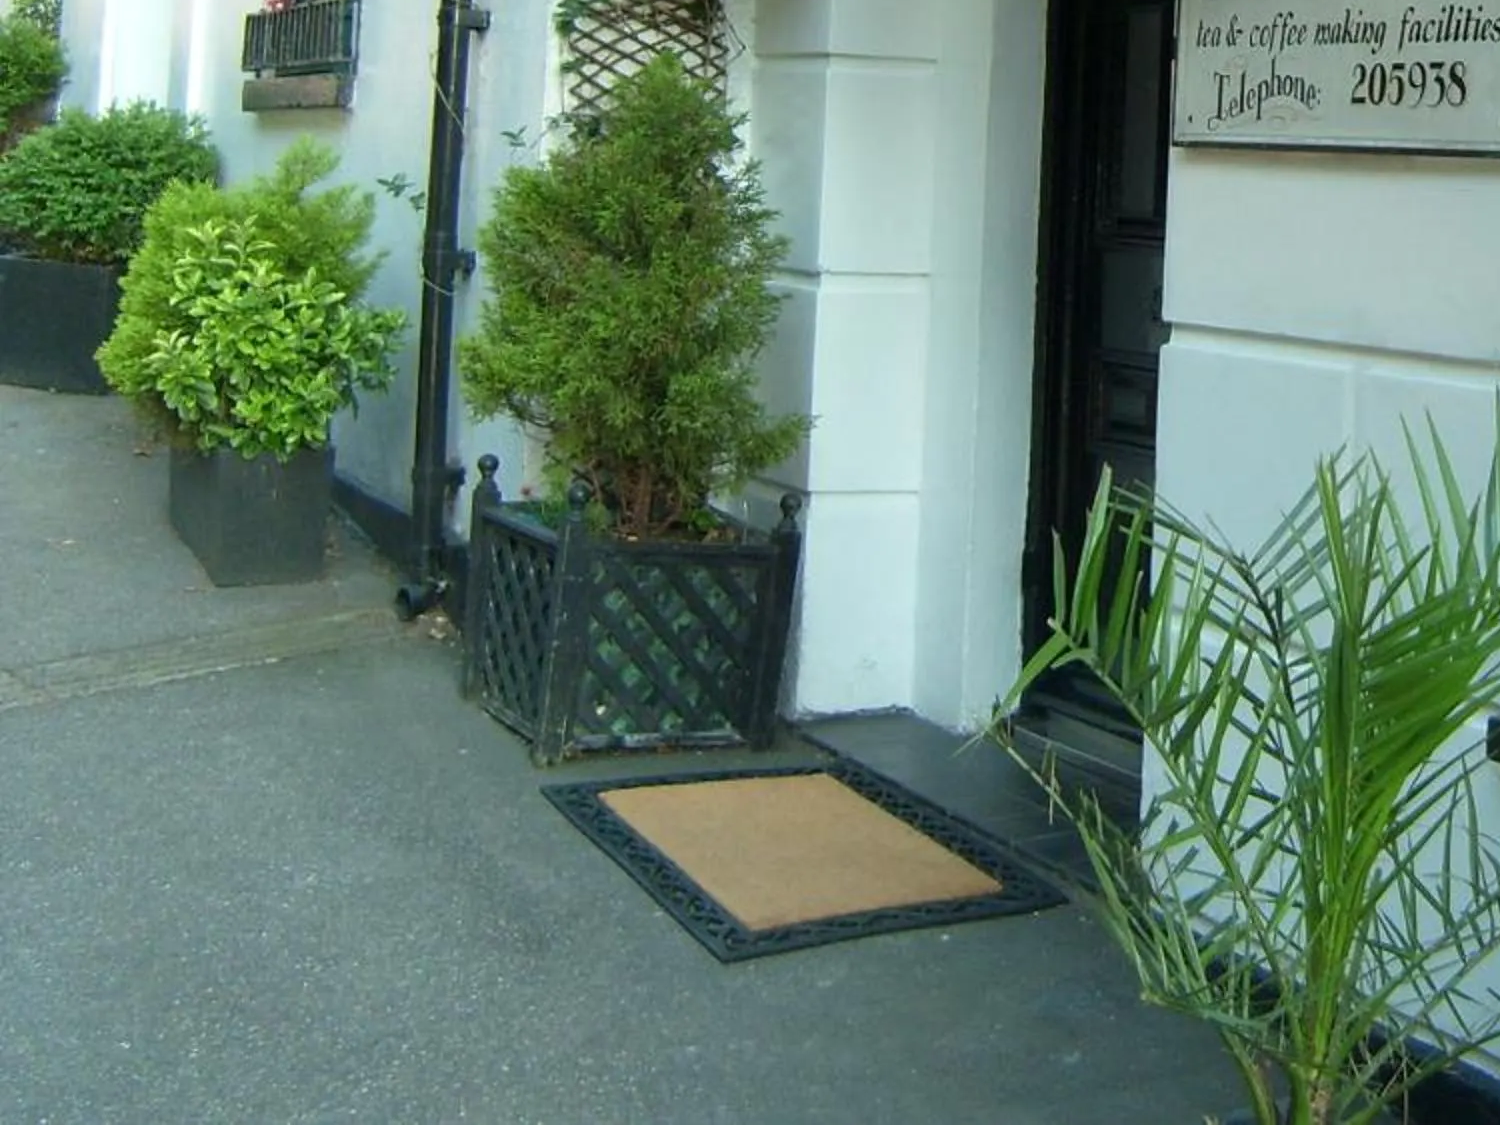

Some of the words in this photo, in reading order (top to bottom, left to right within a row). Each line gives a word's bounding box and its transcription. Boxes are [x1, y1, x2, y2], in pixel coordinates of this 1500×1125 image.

[1196, 18, 1221, 48] tea
[1226, 13, 1244, 48] &
[1249, 11, 1307, 54] coffee
[1313, 9, 1387, 54] making
[1350, 61, 1468, 109] 205938
